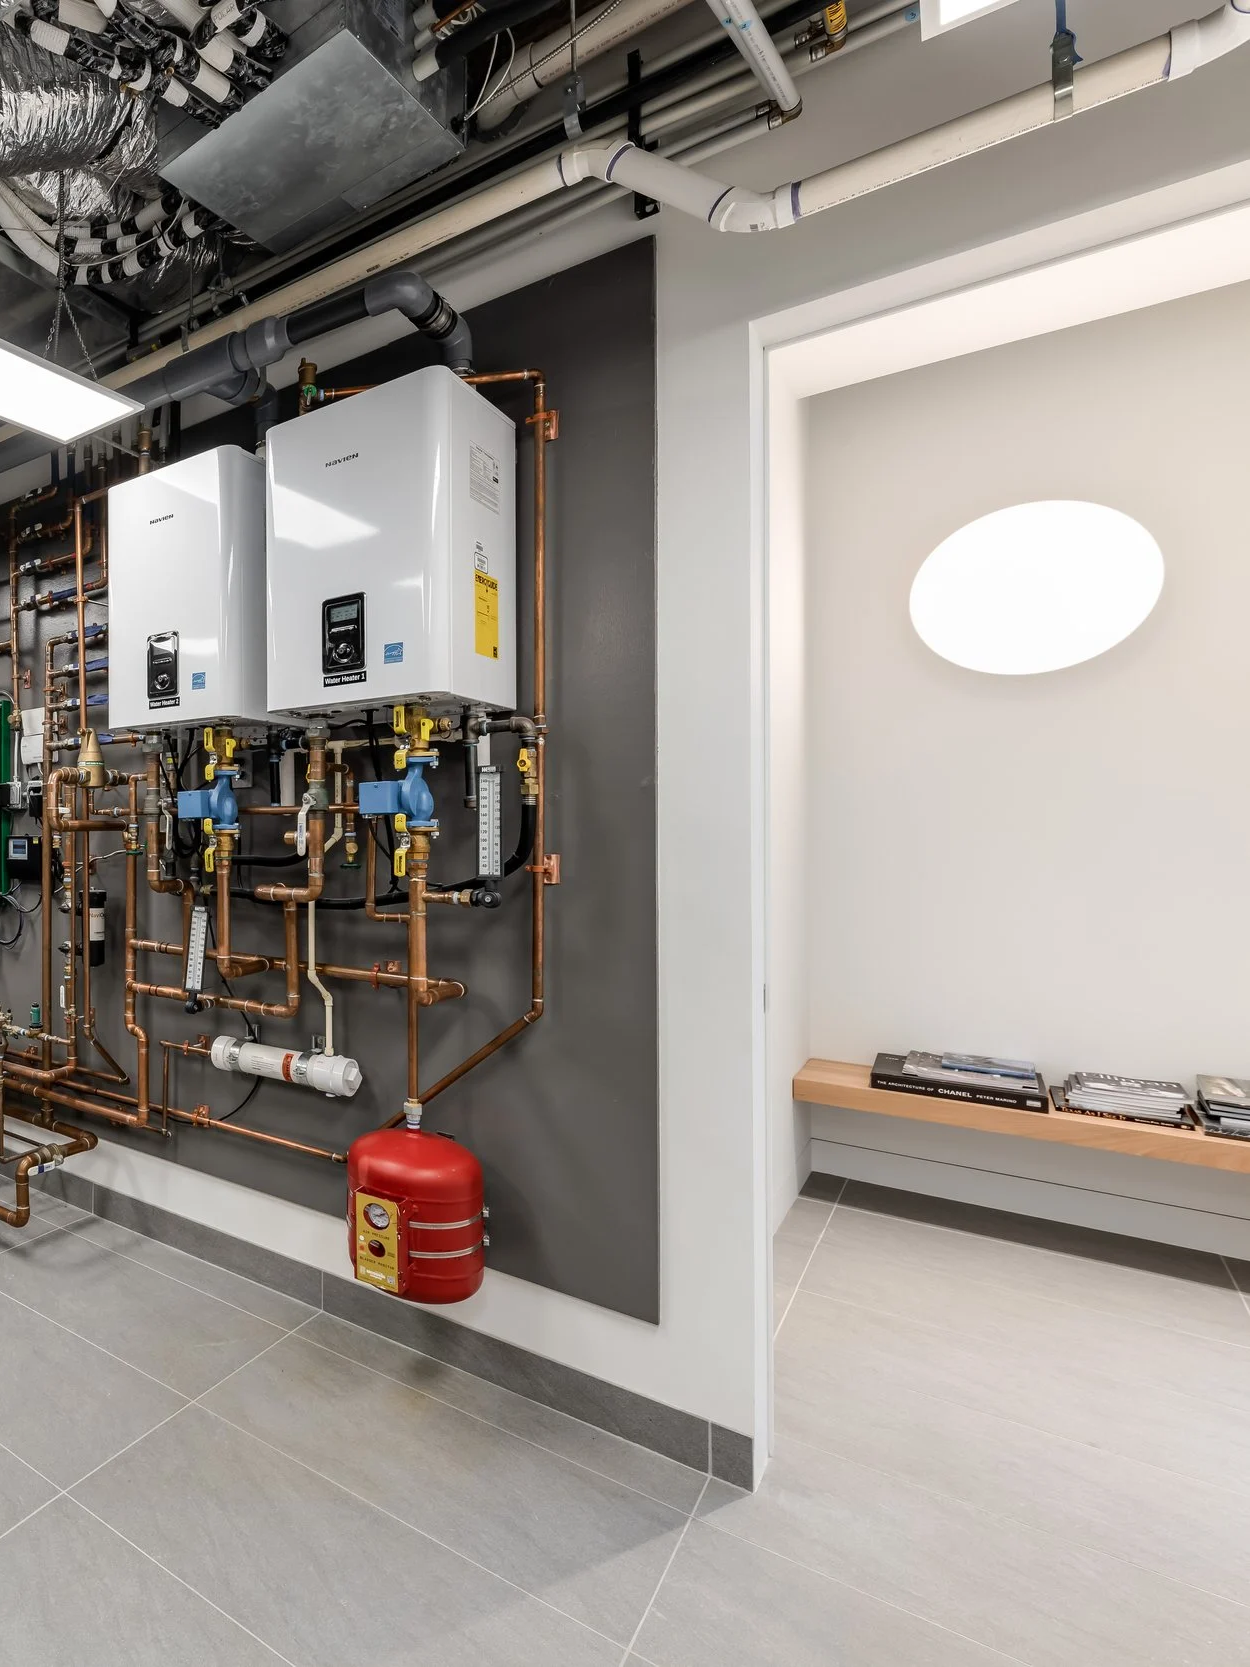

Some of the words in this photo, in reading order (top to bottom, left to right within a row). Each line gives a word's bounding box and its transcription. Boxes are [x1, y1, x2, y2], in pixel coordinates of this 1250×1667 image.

[324, 677, 341, 685] Water
[341, 674, 361, 683] Heater
[361, 672, 366, 680] 1
[888, 1082, 925, 1091] ARCHITECTURE
[937, 1088, 973, 1098] CHANEL
